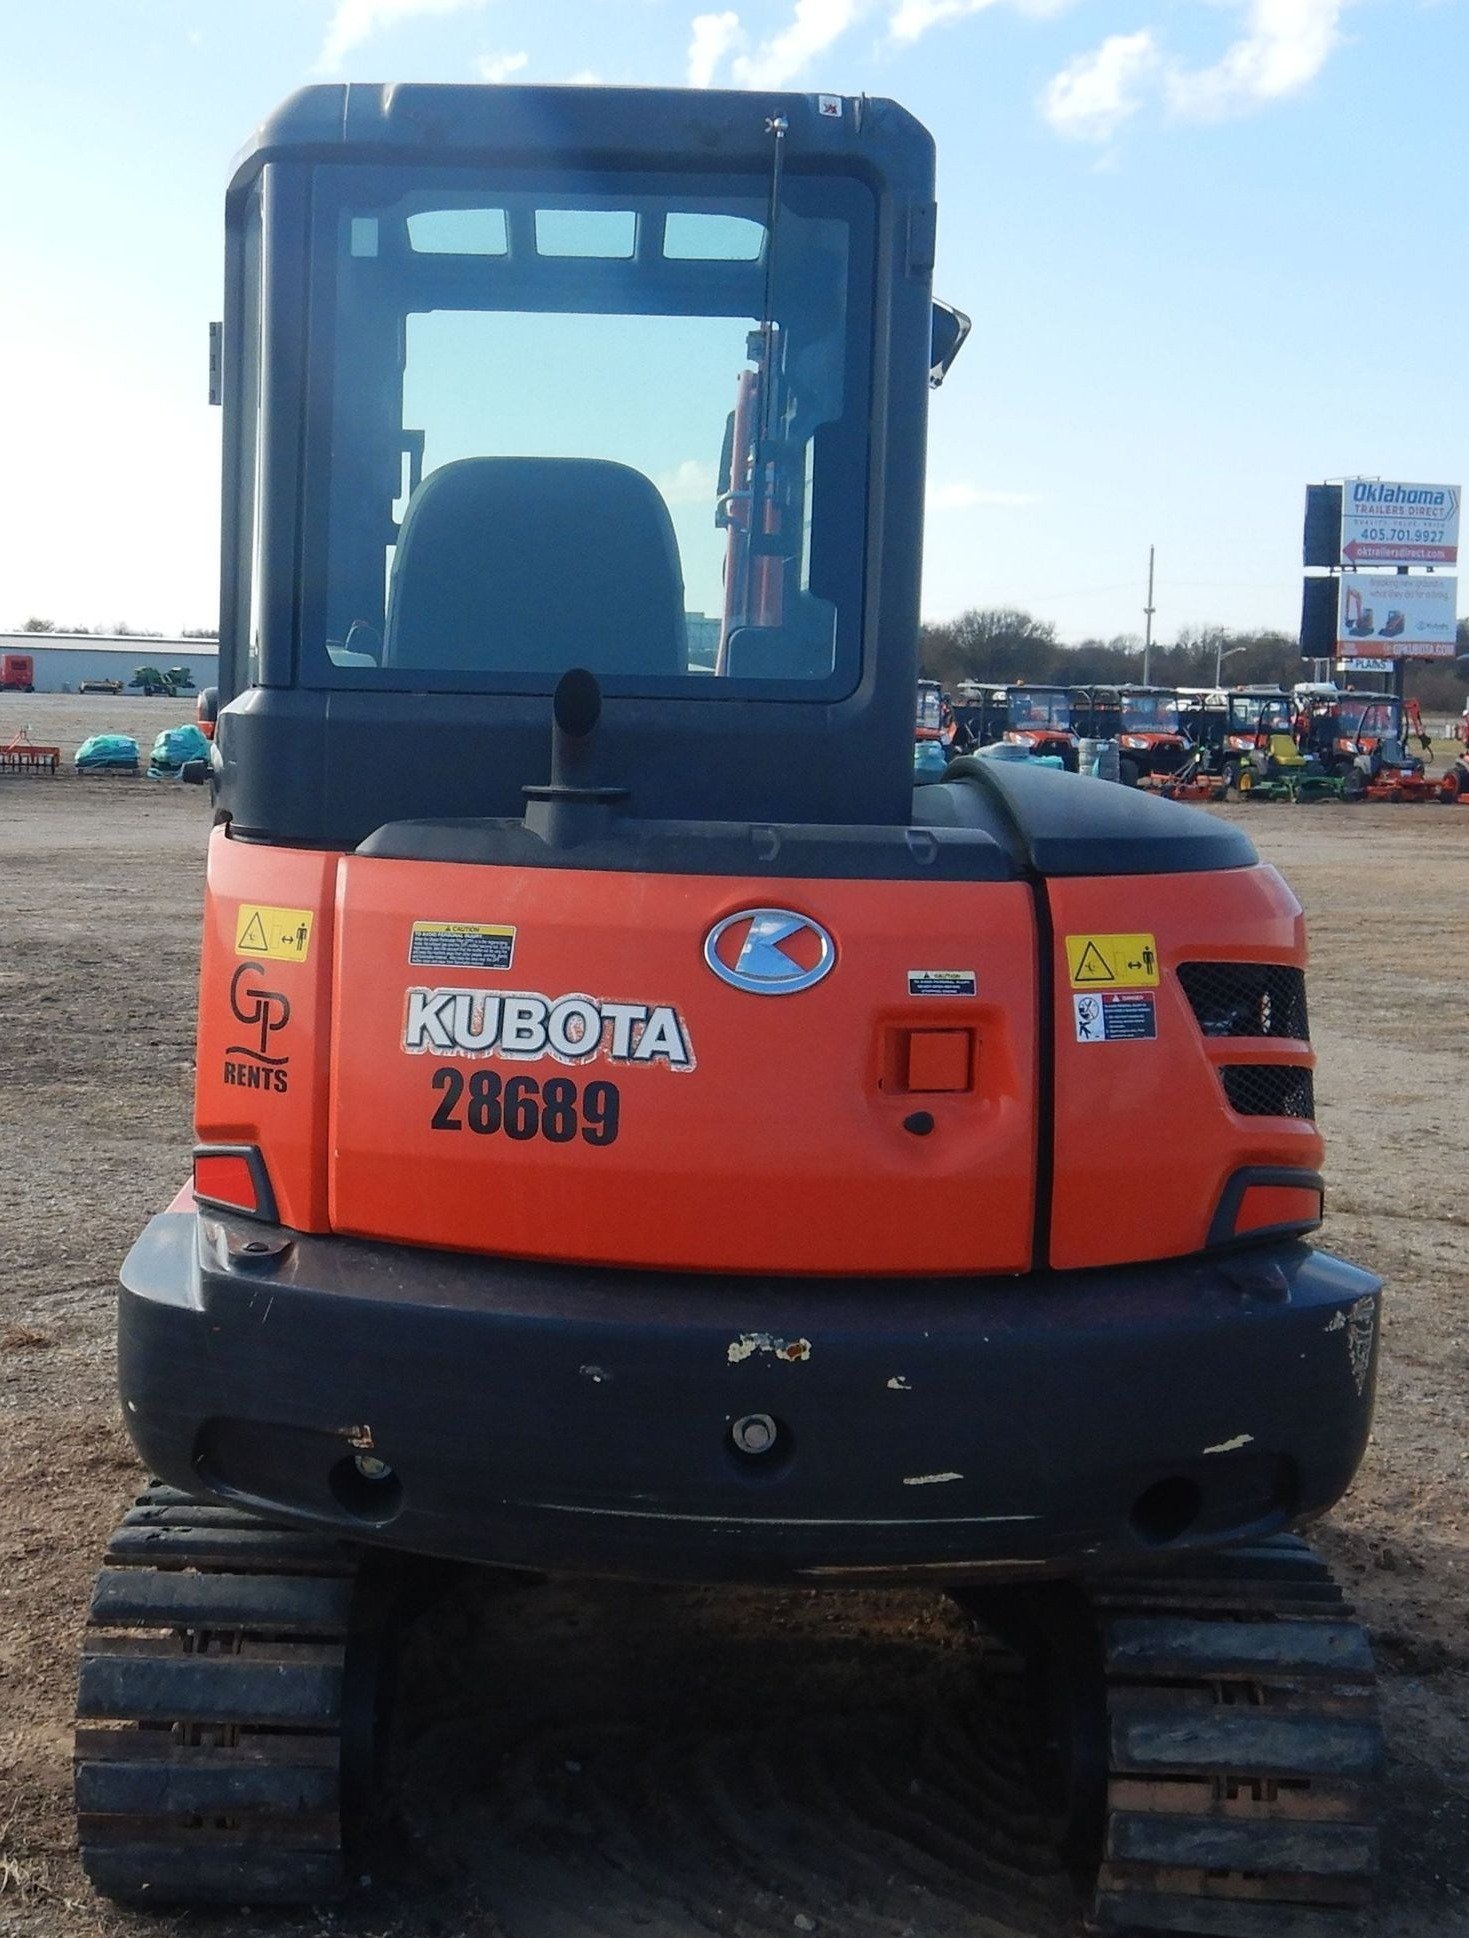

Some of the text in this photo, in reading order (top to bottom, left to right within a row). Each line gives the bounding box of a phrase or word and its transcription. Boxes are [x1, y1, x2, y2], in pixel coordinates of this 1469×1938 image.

[1353, 483, 1444, 505] Oklahoma
[1354, 504, 1445, 517] TRAILERS DIRECT
[1361, 528, 1445, 543] 405.701.9927
[1355, 659, 1387, 670] PLAINS
[404, 989, 692, 1066] KUBOTA
[224, 1061, 288, 1093] RENTS
[430, 1067, 620, 1147] 28689
